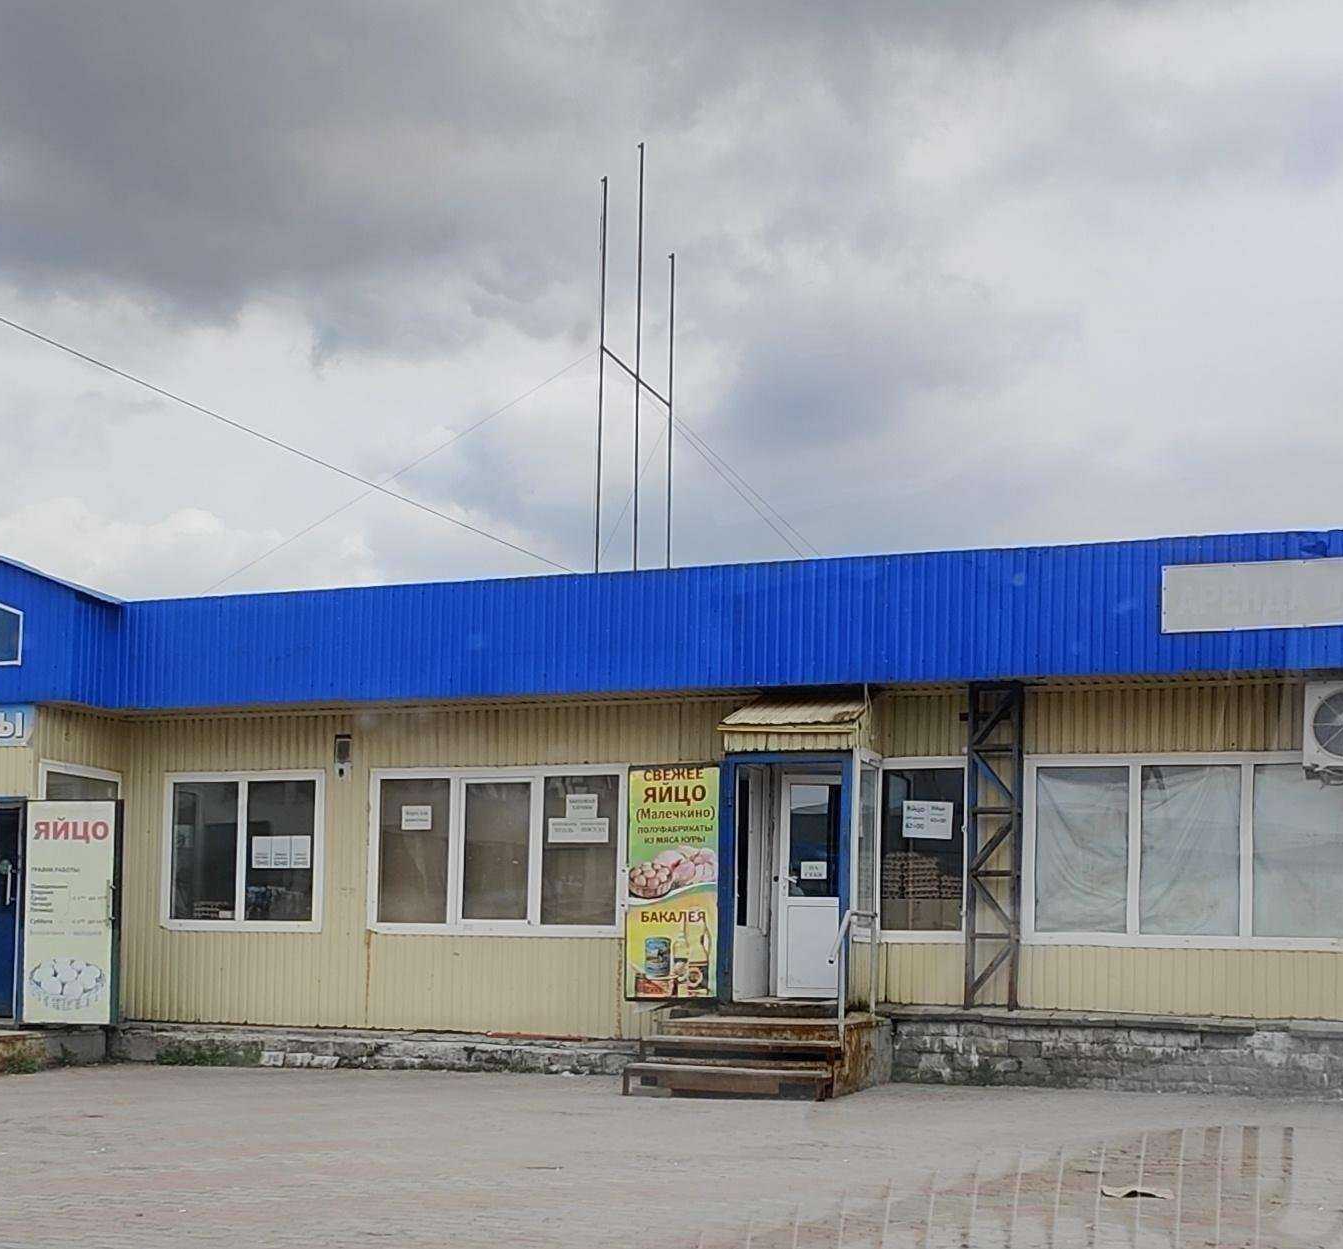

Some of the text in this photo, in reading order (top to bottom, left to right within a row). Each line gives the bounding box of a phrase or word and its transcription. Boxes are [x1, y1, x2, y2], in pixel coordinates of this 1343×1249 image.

[643, 767, 704, 781] СВЕЖЕЕ
[643, 782, 707, 806] ЯЙЦО
[636, 806, 716, 823] (Малечкино)
[34, 817, 110, 844] ЯЙЦО
[637, 824, 714, 834] ПОЛУФАБРИКАТЫ
[655, 836, 679, 844] МЯСА
[640, 910, 706, 923] БАКАЛЕЯ
